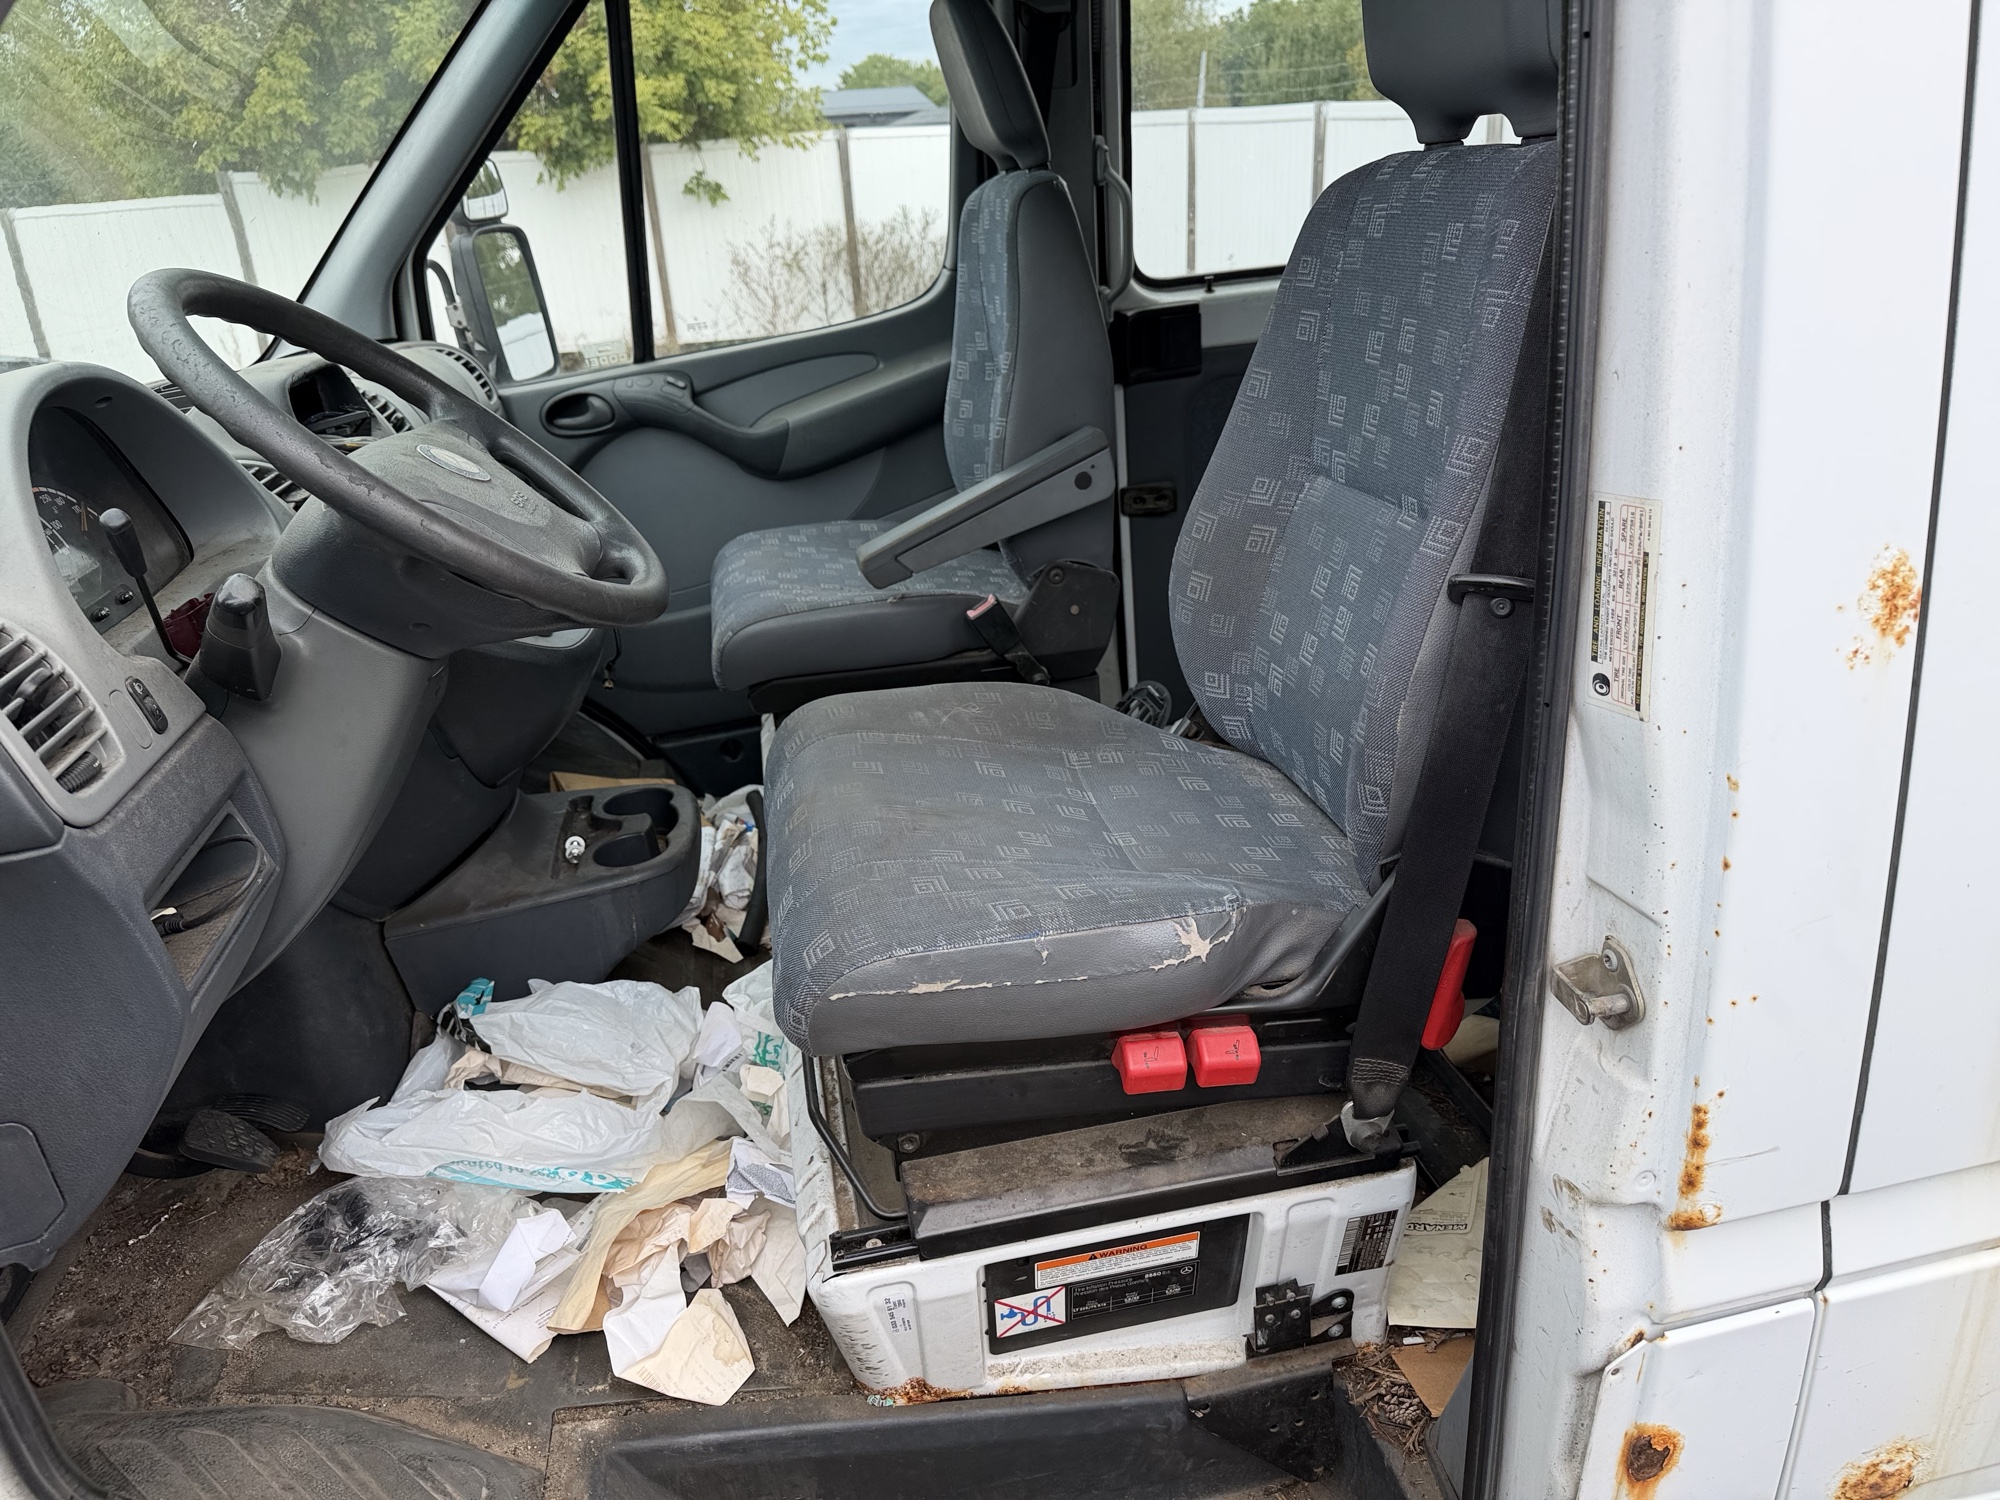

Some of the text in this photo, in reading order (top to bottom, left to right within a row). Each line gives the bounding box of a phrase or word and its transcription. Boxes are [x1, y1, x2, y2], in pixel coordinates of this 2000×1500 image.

[510, 490, 528, 508] SRS
[1596, 507, 1604, 566] INFORMATION
[1099, 1244, 1148, 1258] WARNING
[1086, 1282, 1107, 1290] Inflation
[1107, 1277, 1132, 1286] Pressure
[1073, 1287, 1097, 1296] Pression
